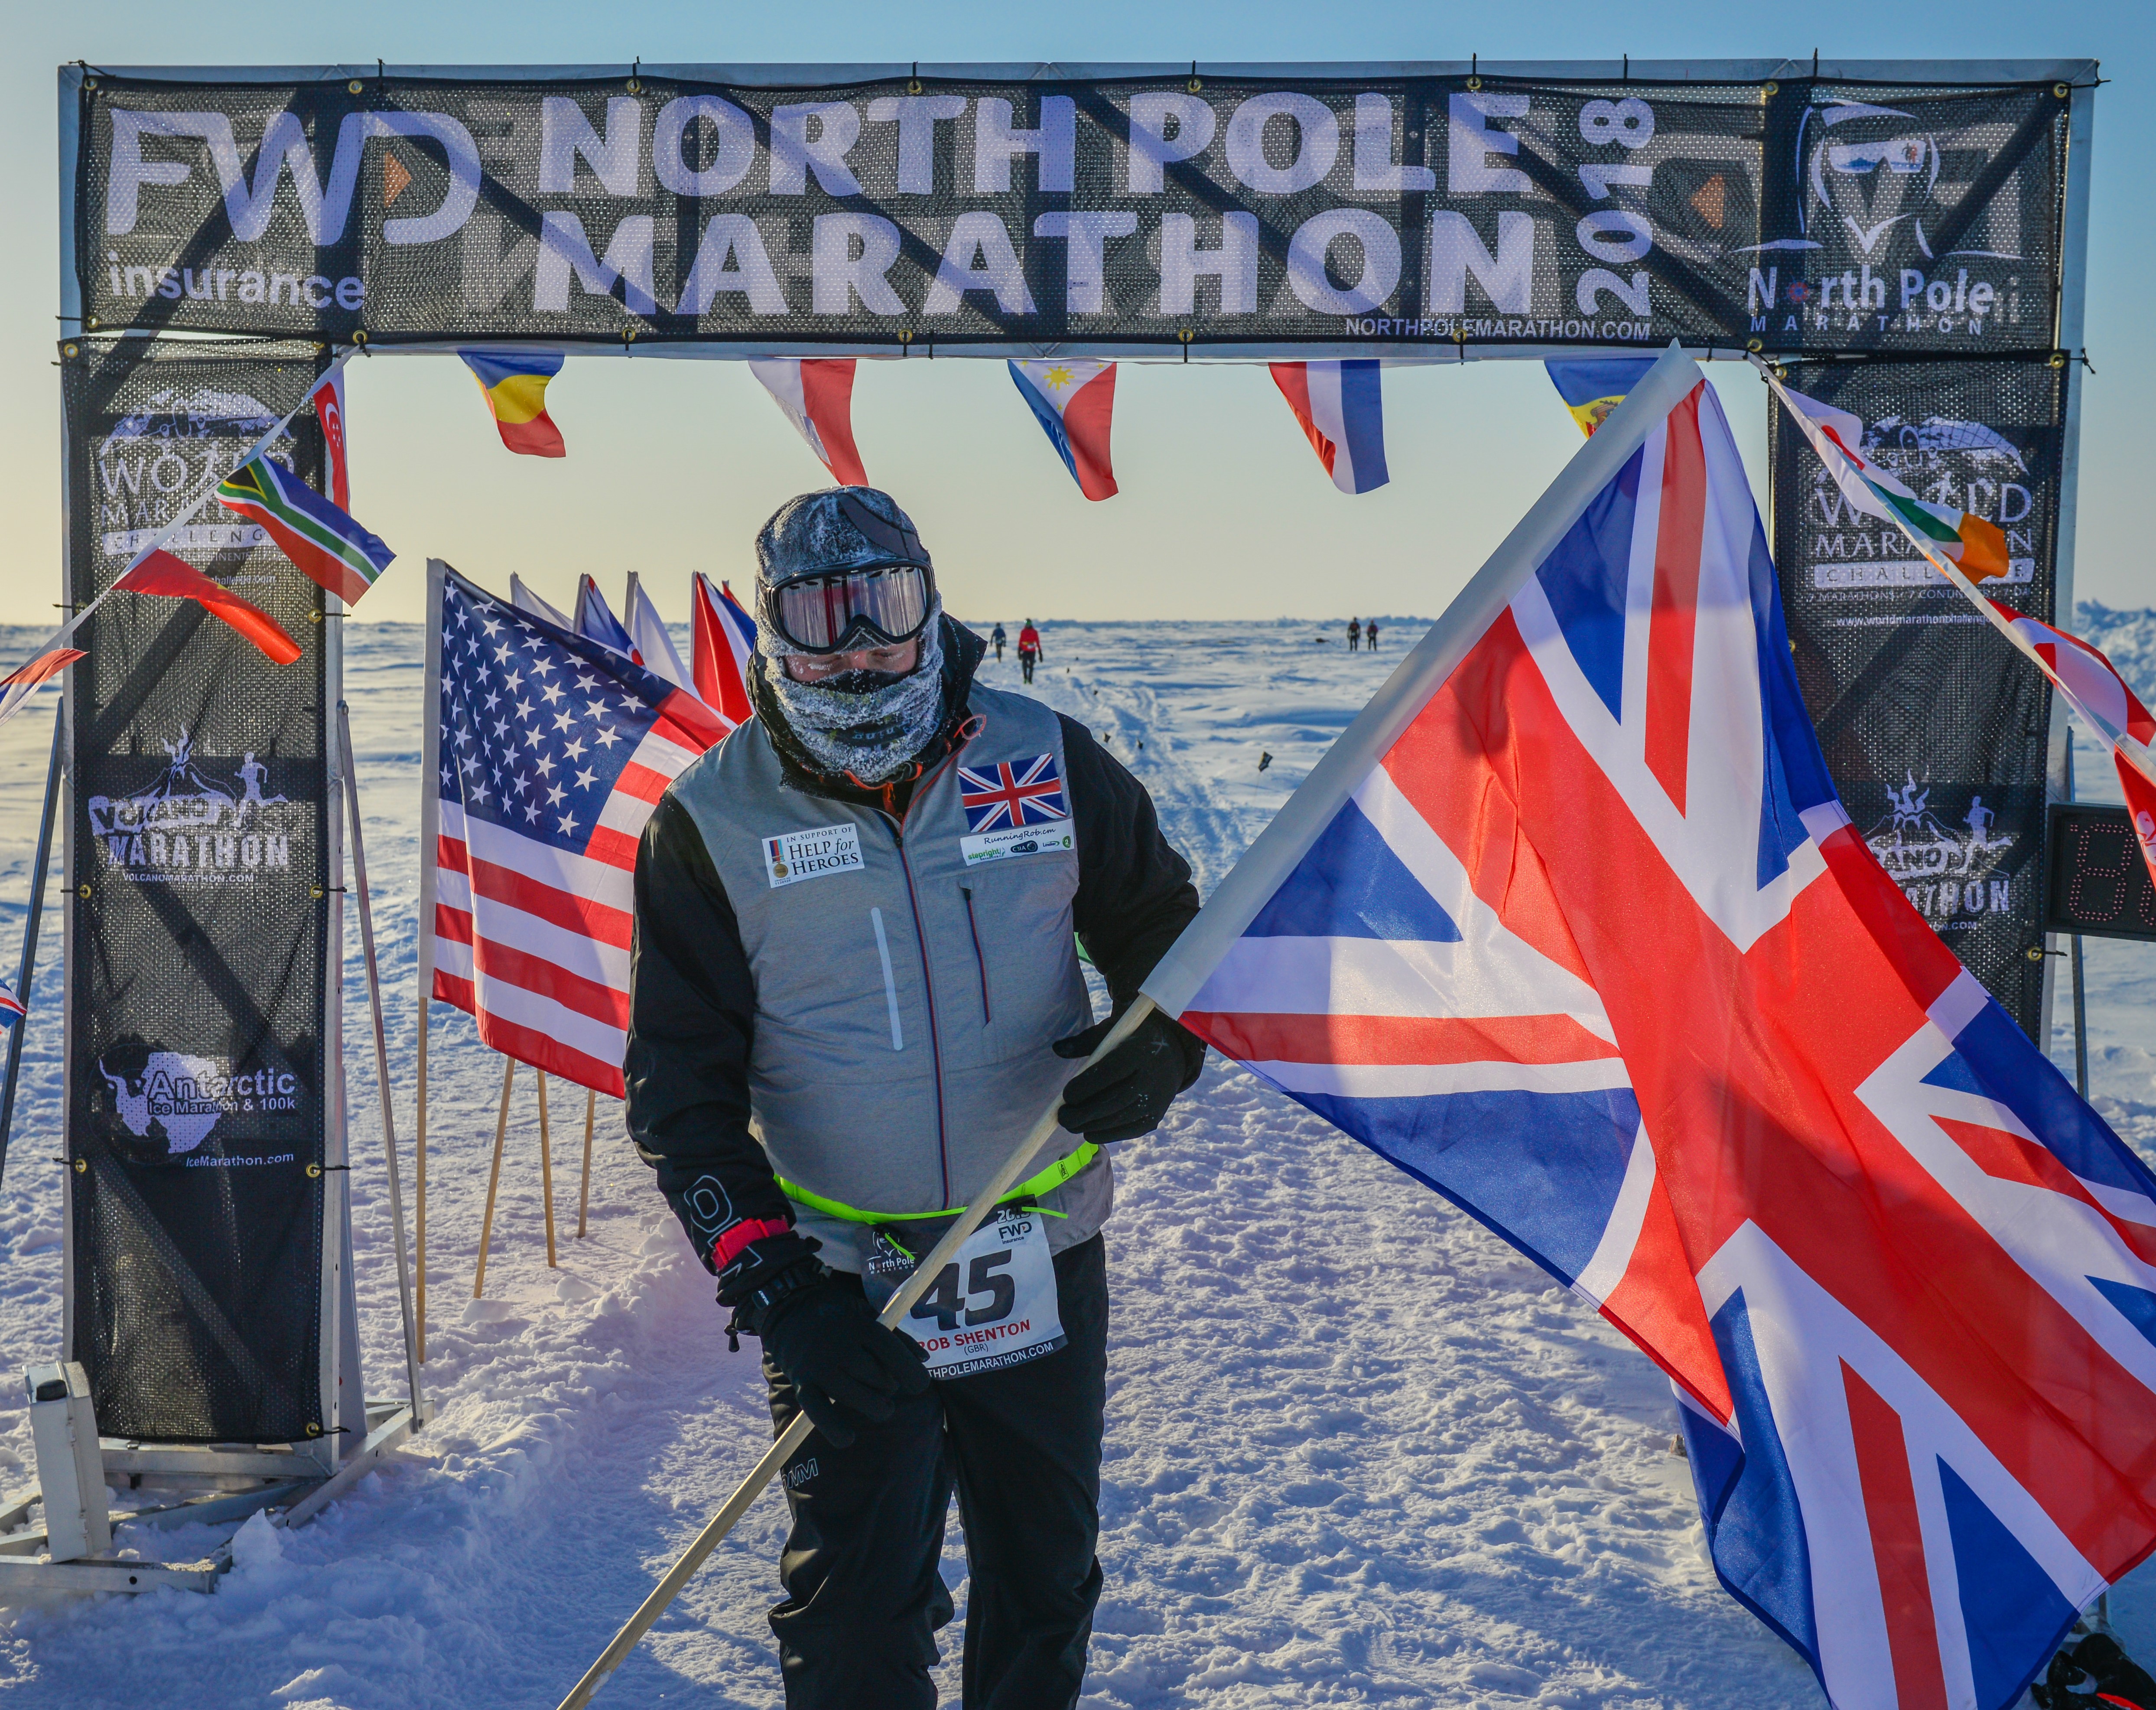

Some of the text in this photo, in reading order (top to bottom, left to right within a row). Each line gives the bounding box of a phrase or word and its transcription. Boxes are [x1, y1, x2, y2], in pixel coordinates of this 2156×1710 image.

[539, 91, 1533, 197] NORTH POLE
[107, 108, 481, 246] FWD
[1577, 97, 1655, 316] 2018
[533, 208, 1535, 315] MARATHON
[108, 250, 364, 310] insurance
[1900, 268, 1993, 313] Pole
[1346, 317, 1650, 340] NORTHPOLEMARATHON.COM
[1750, 315, 1981, 335] MARATHON
[1819, 590, 1895, 602] MARATHONS
[800, 829, 838, 840] SUPPORT
[107, 834, 289, 867] MARATHON
[788, 838, 855, 860] HELP for
[968, 848, 999, 860] stepright
[791, 852, 858, 876] HEROES
[123, 873, 254, 883] VOLCANOMARATHON.COM
[148, 1068, 295, 1099] Antarctic
[149, 1101, 171, 1114] Ice
[176, 1101, 237, 1114] Marathon
[260, 1097, 295, 1110] 100k
[186, 1153, 293, 1167] IceMarathon.com
[998, 1221, 1032, 1239] FWD
[1002, 1236, 1024, 1244] insurance
[896, 1256, 914, 1266] Pole
[910, 1248, 1015, 1331] 45
[954, 1319, 1031, 1346] SHENTON
[964, 1343, 989, 1356] (GBR)
